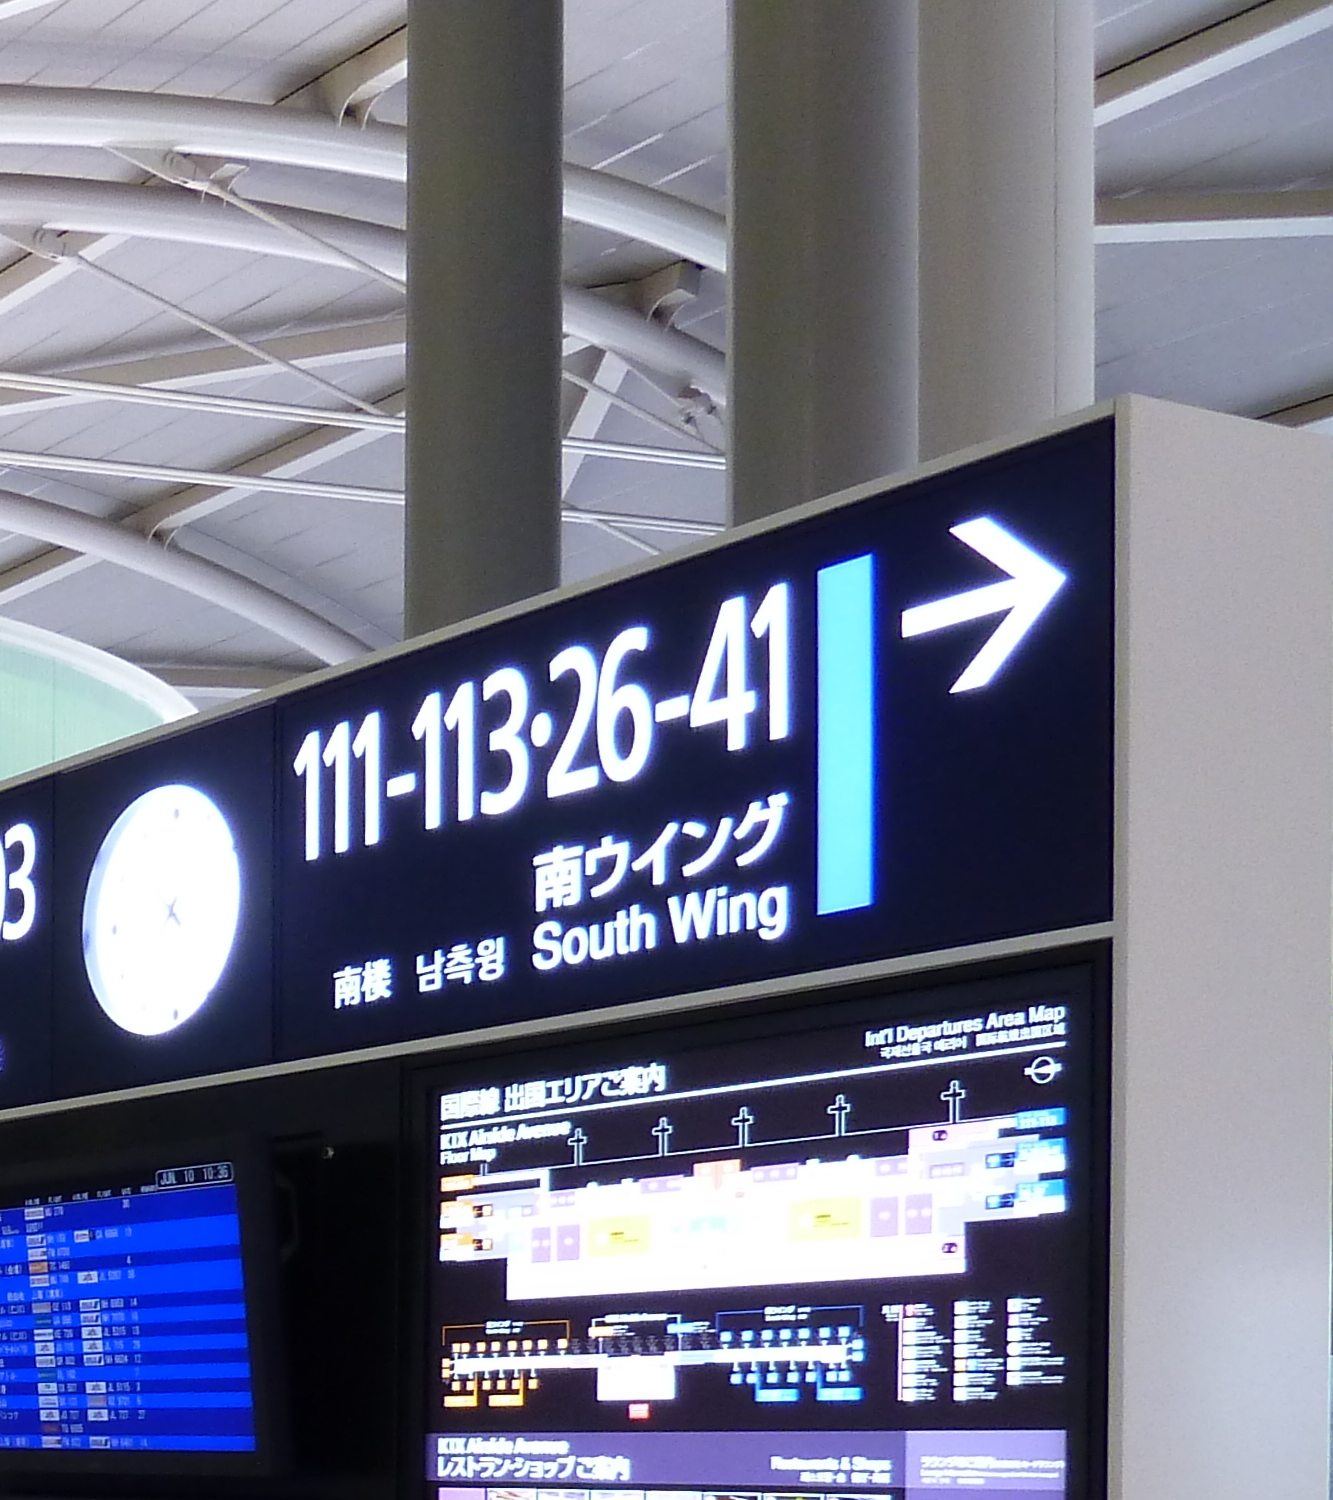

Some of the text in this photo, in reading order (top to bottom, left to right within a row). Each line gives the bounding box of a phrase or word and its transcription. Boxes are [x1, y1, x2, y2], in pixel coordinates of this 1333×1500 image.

[533, 792, 789, 912] 南ウイング
[532, 886, 789, 971] South Wing
[416, 937, 506, 993] 남측윙
[896, 1018, 983, 1042] Departures
[986, 1012, 1025, 1029] Area
[1029, 1006, 1065, 1023] Map
[183, 1170, 194, 1183] 10
